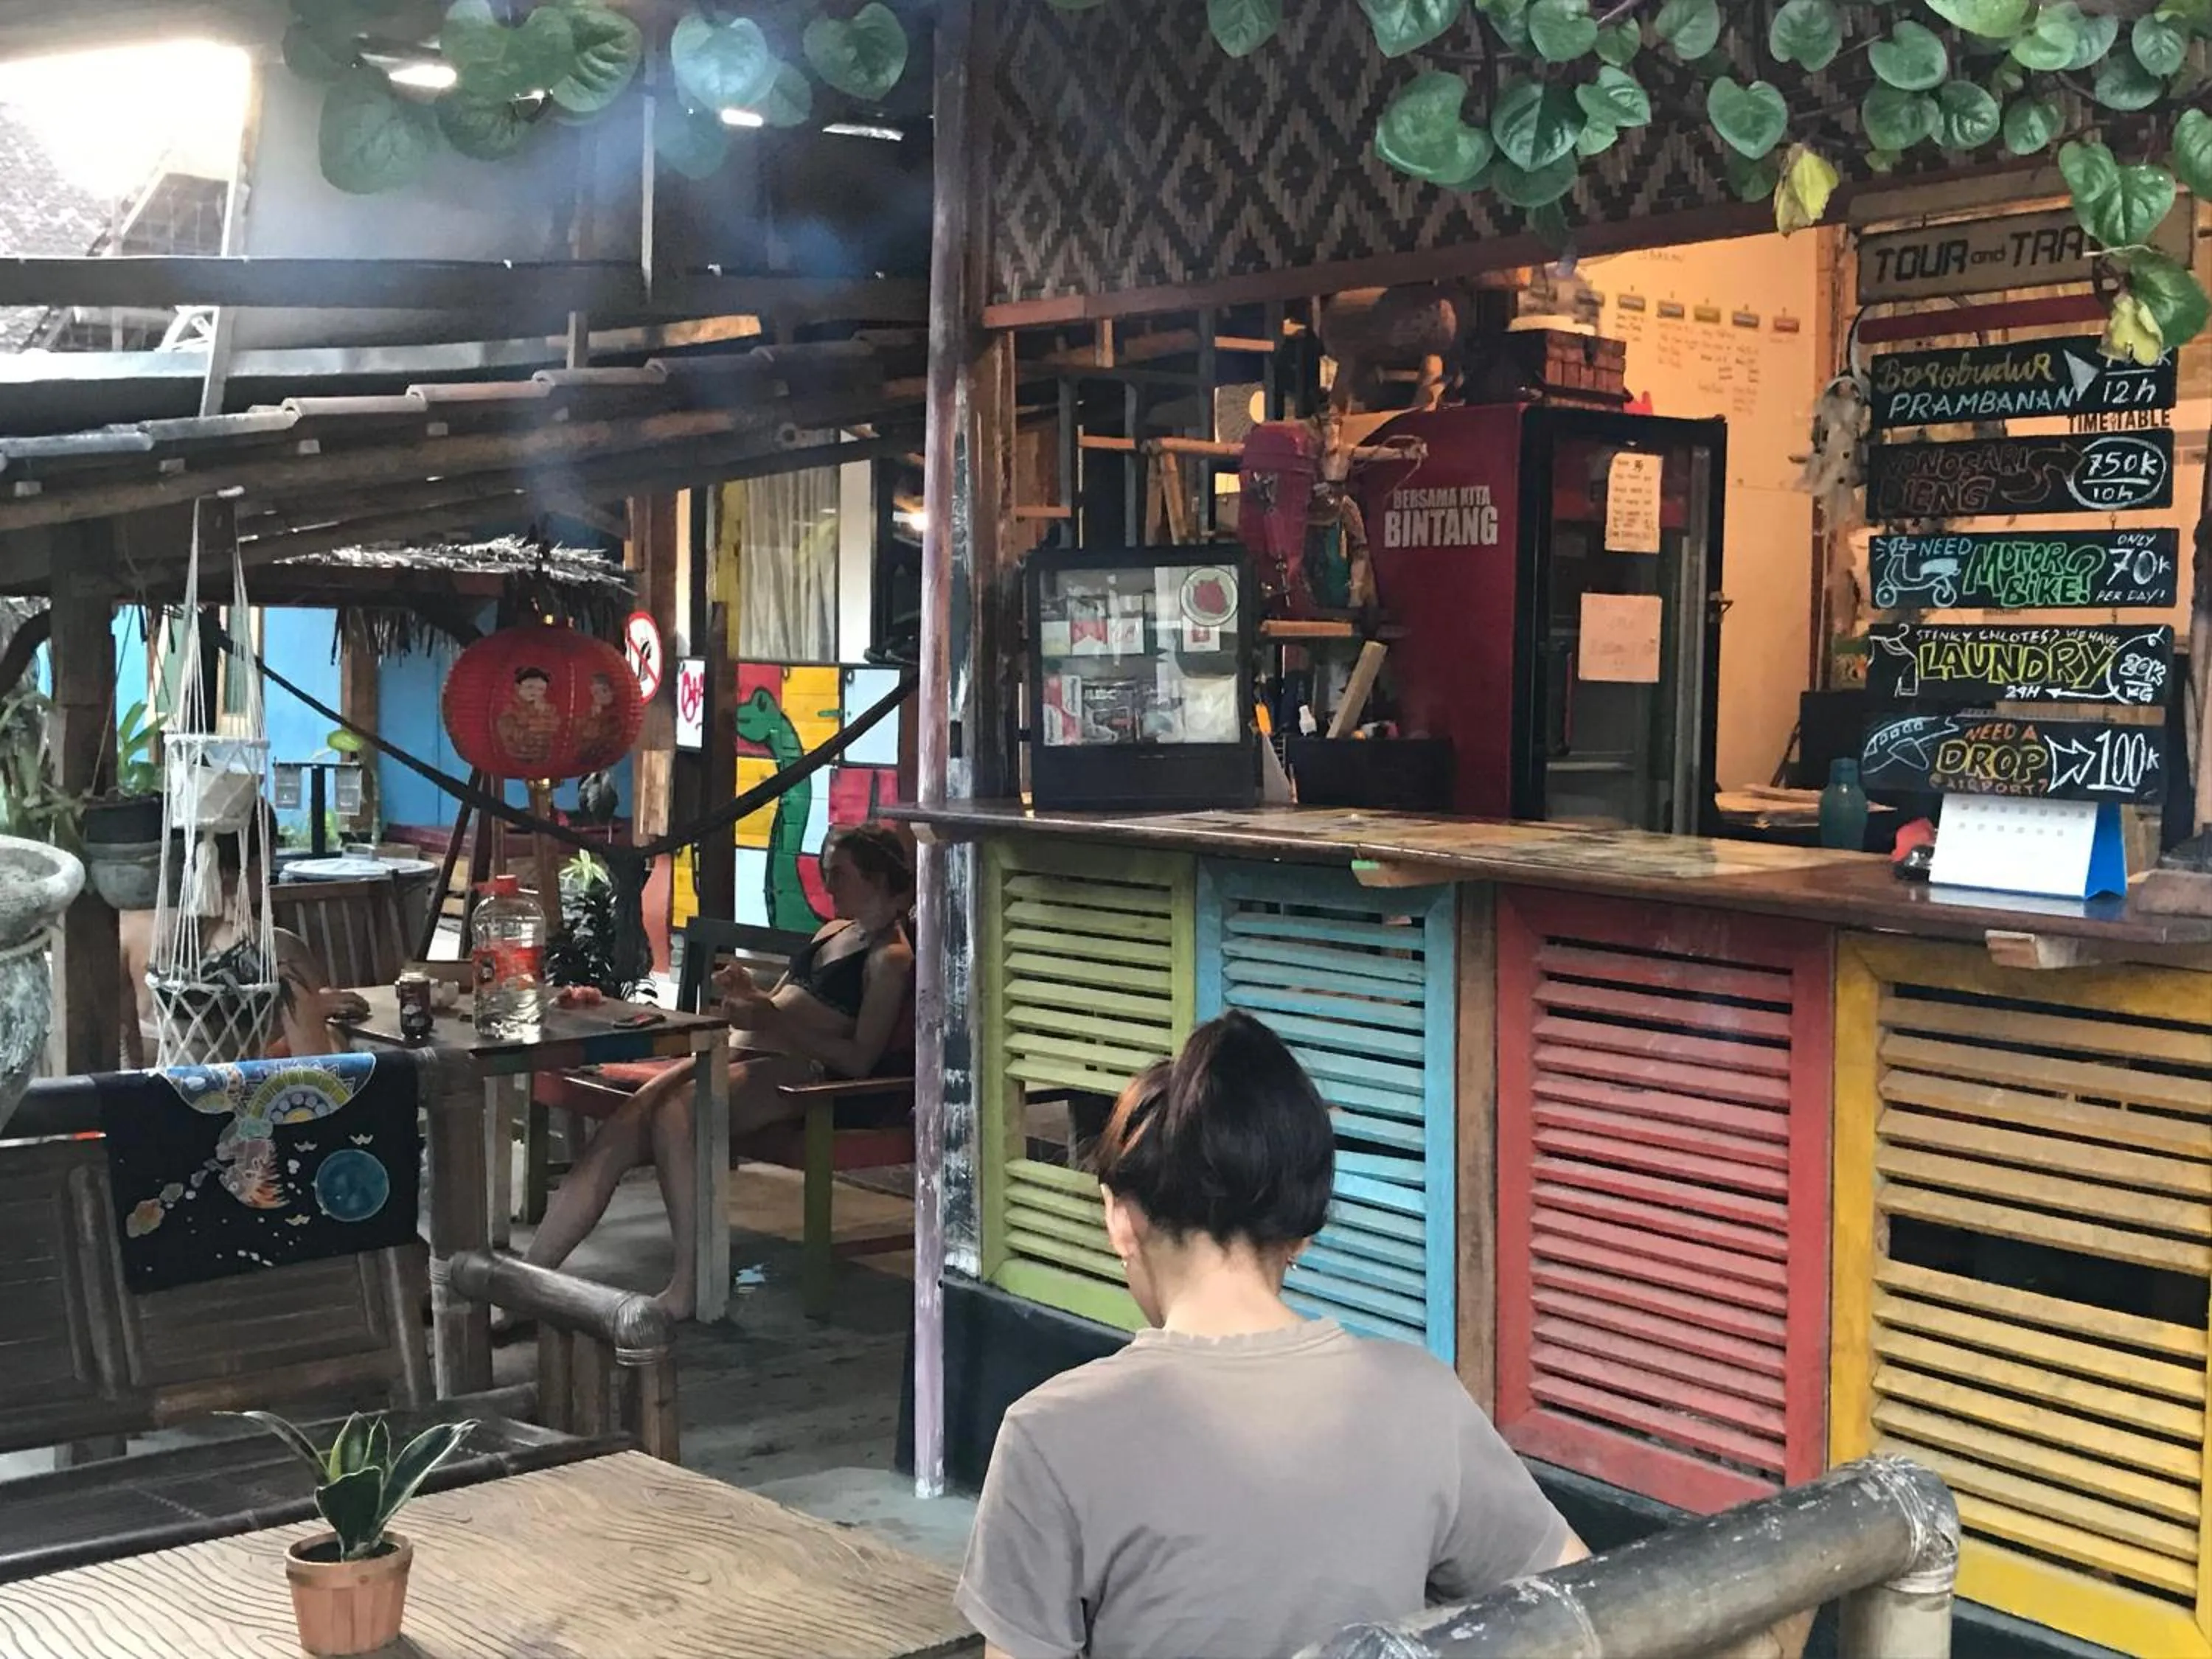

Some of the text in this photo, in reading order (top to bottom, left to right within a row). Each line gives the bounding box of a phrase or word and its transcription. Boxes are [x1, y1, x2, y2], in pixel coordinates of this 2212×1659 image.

[1875, 225, 2083, 283] TOUR and TRA
[1888, 385, 2076, 420] PRAMBANAN
[2067, 408, 2170, 434] TIME TABLE
[1393, 484, 1491, 509] BERSAMA KITA
[1384, 505, 1498, 548] BINTANG
[2117, 533, 2157, 547] ONLY
[1919, 538, 2067, 598] NEED MOTOR
[2096, 589, 2123, 602] PER
[1917, 630, 1972, 642] STINKY
[2066, 629, 2086, 641] WE
[2088, 631, 2120, 650] HAVE
[1919, 638, 2118, 689] LAUNDRY
[2005, 684, 2040, 699] 24H
[2126, 686, 2154, 703] KG
[1965, 722, 2039, 741] NEED A
[1935, 739, 2049, 783] DROP
[1946, 778, 2049, 796] AIRPORT?
